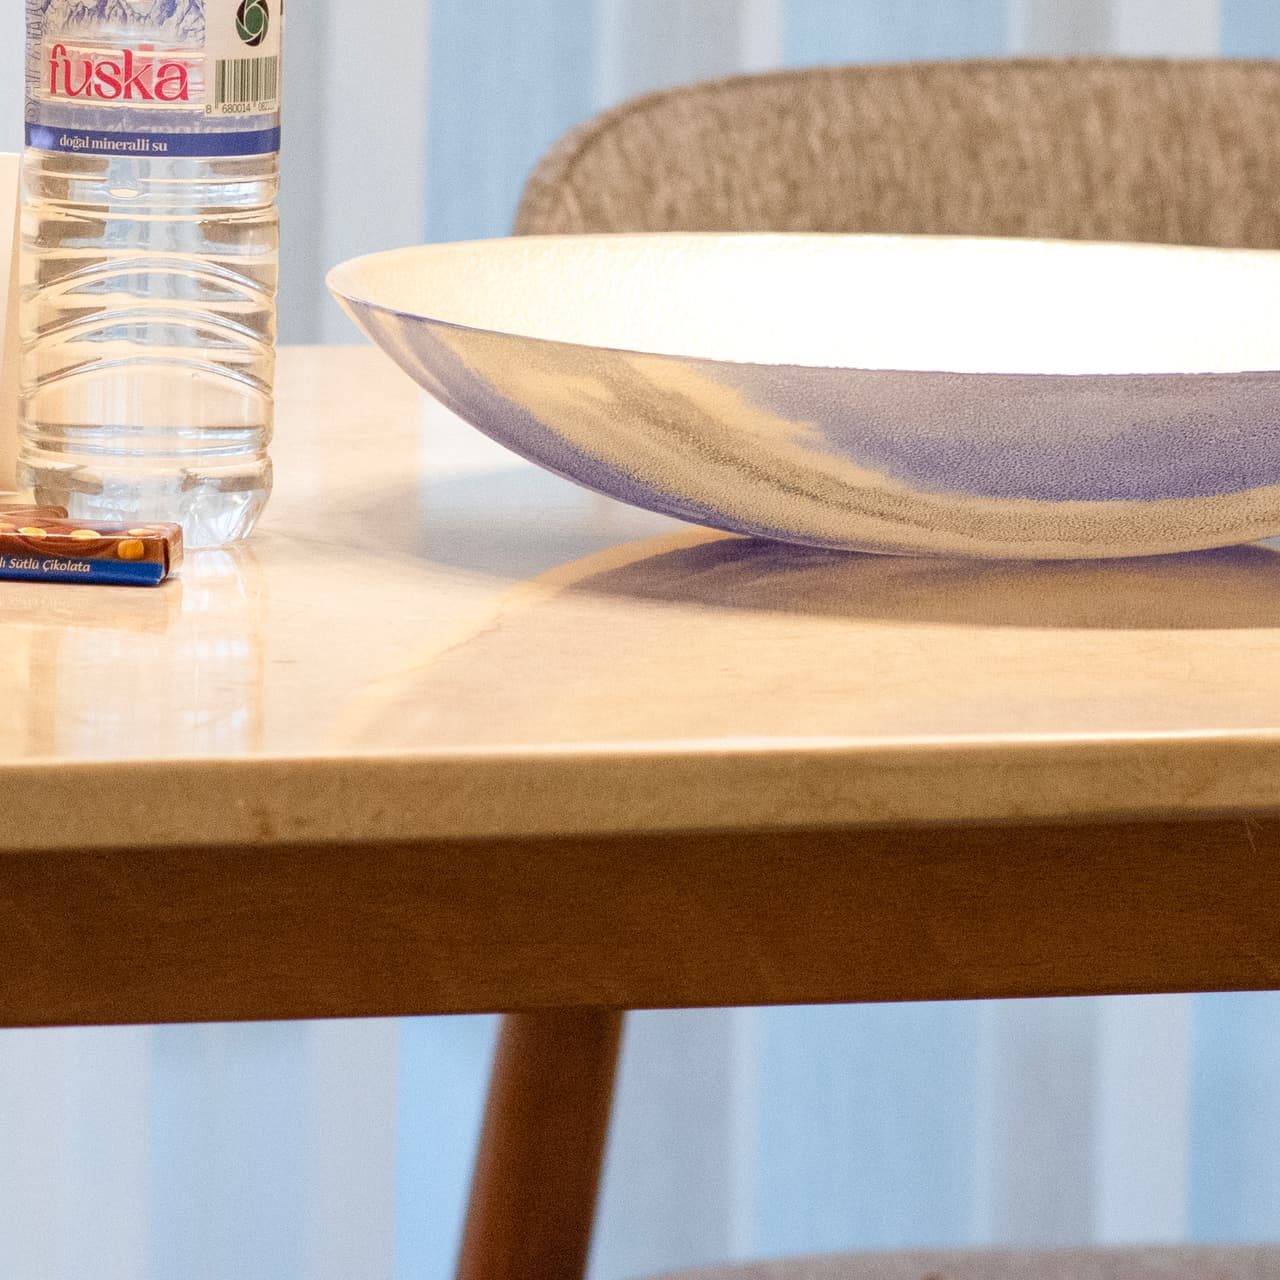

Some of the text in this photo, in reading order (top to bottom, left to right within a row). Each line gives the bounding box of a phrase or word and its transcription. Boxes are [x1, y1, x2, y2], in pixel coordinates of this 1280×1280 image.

[49, 43, 189, 101] fuska
[205, 104, 212, 114] 8
[222, 103, 251, 114] 680014
[60, 134, 168, 152] doğal mineralli su
[8, 558, 40, 571] Sütlü
[42, 559, 91, 574] Çikolata
